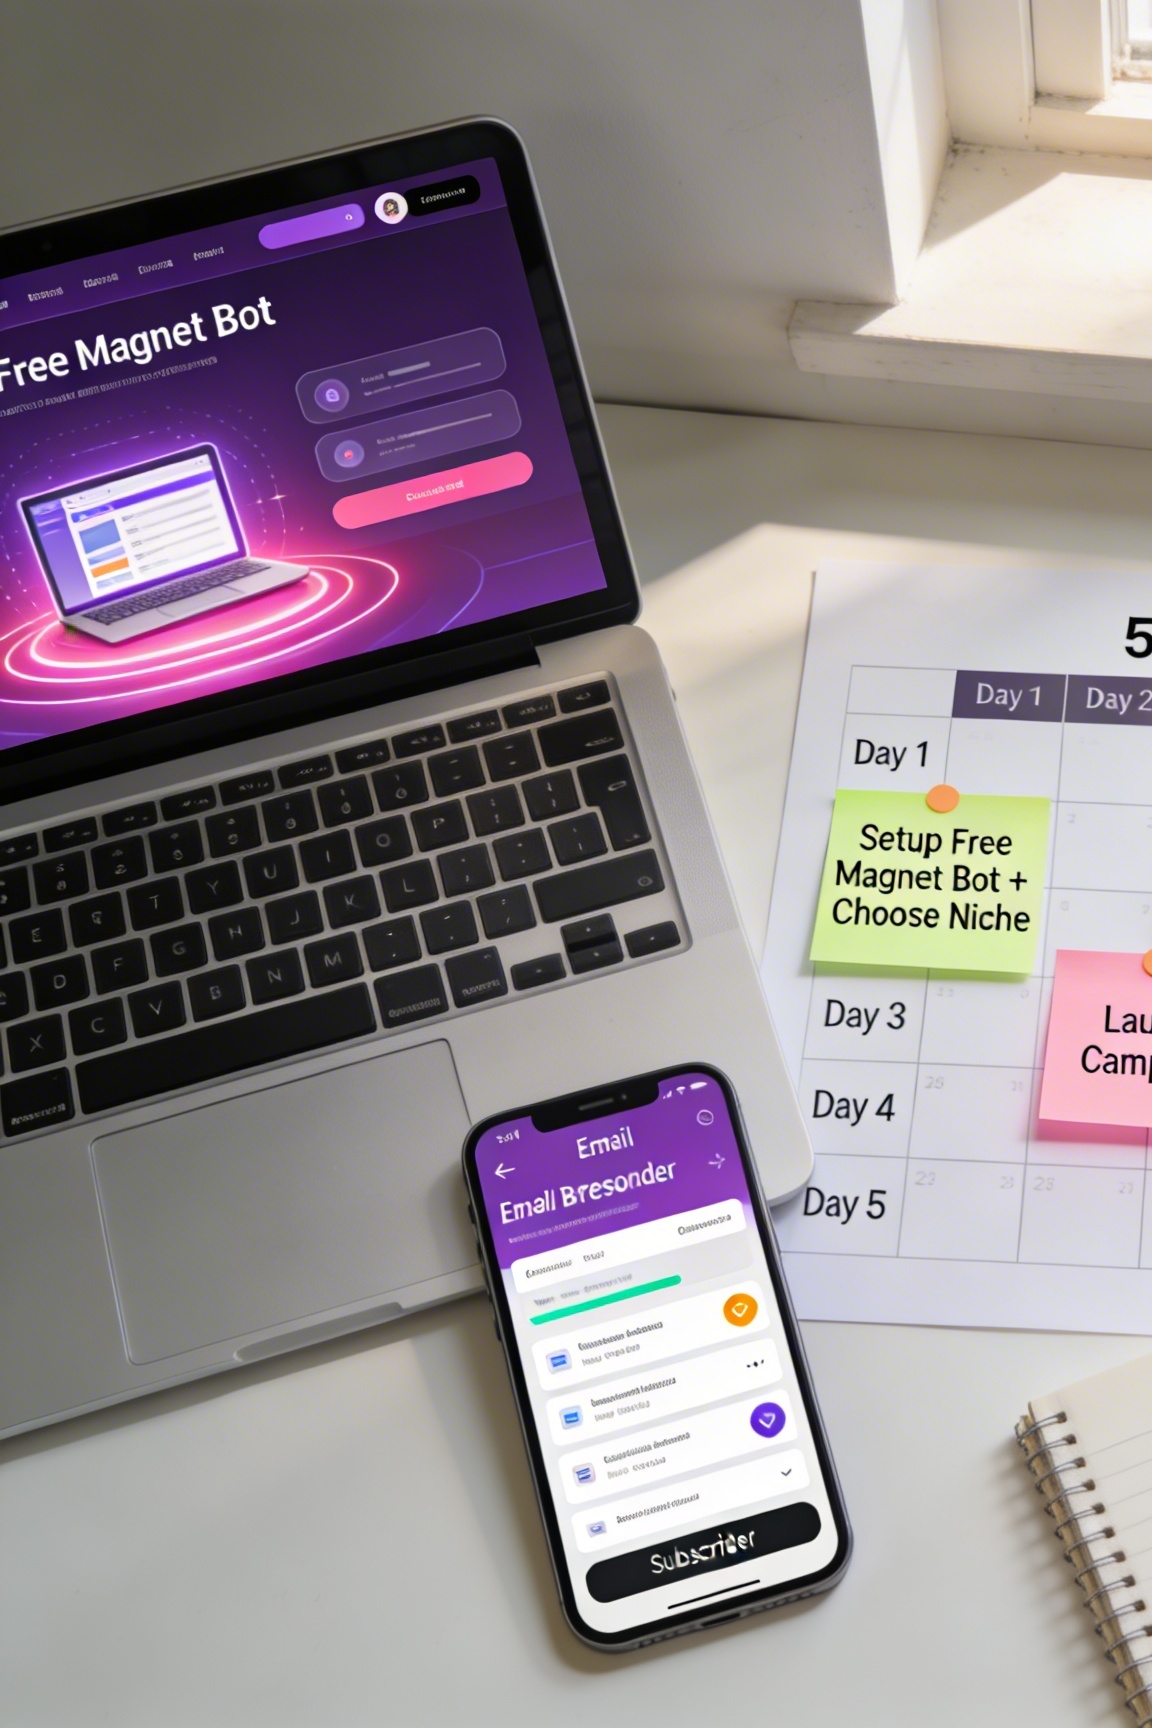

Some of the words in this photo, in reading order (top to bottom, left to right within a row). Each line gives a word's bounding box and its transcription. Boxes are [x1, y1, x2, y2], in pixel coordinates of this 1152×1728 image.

[0, 352, 70, 393] Free
[74, 312, 208, 371] Magnet
[211, 296, 277, 338] Bot
[976, 682, 1023, 710] Day
[1029, 686, 1041, 706] 1
[1086, 686, 1133, 714] Day
[854, 738, 907, 772] Day
[916, 740, 928, 768] 1
[432, 817, 445, 829] P
[375, 833, 391, 848] O
[859, 823, 943, 859] Setup
[951, 828, 1013, 856] Free
[263, 864, 277, 880] U
[835, 859, 944, 895] Magnet
[952, 864, 1001, 893] Bot
[1009, 871, 1028, 892] +
[206, 880, 219, 895] Y
[402, 879, 416, 893] L
[149, 894, 159, 910] T
[832, 896, 940, 929] Choose
[949, 901, 1031, 933] Niche
[172, 941, 187, 956] G
[323, 951, 342, 967] M
[53, 974, 67, 990] D
[267, 969, 282, 983] N
[148, 1000, 162, 1015] V
[90, 1017, 105, 1034] C
[824, 998, 880, 1036] Day
[886, 1001, 906, 1030] 3
[29, 1034, 42, 1053] X
[812, 1089, 869, 1127] Day
[875, 1093, 896, 1122] 4
[576, 1126, 634, 1160] Email
[802, 1186, 860, 1226] Day
[866, 1189, 887, 1220] 5
